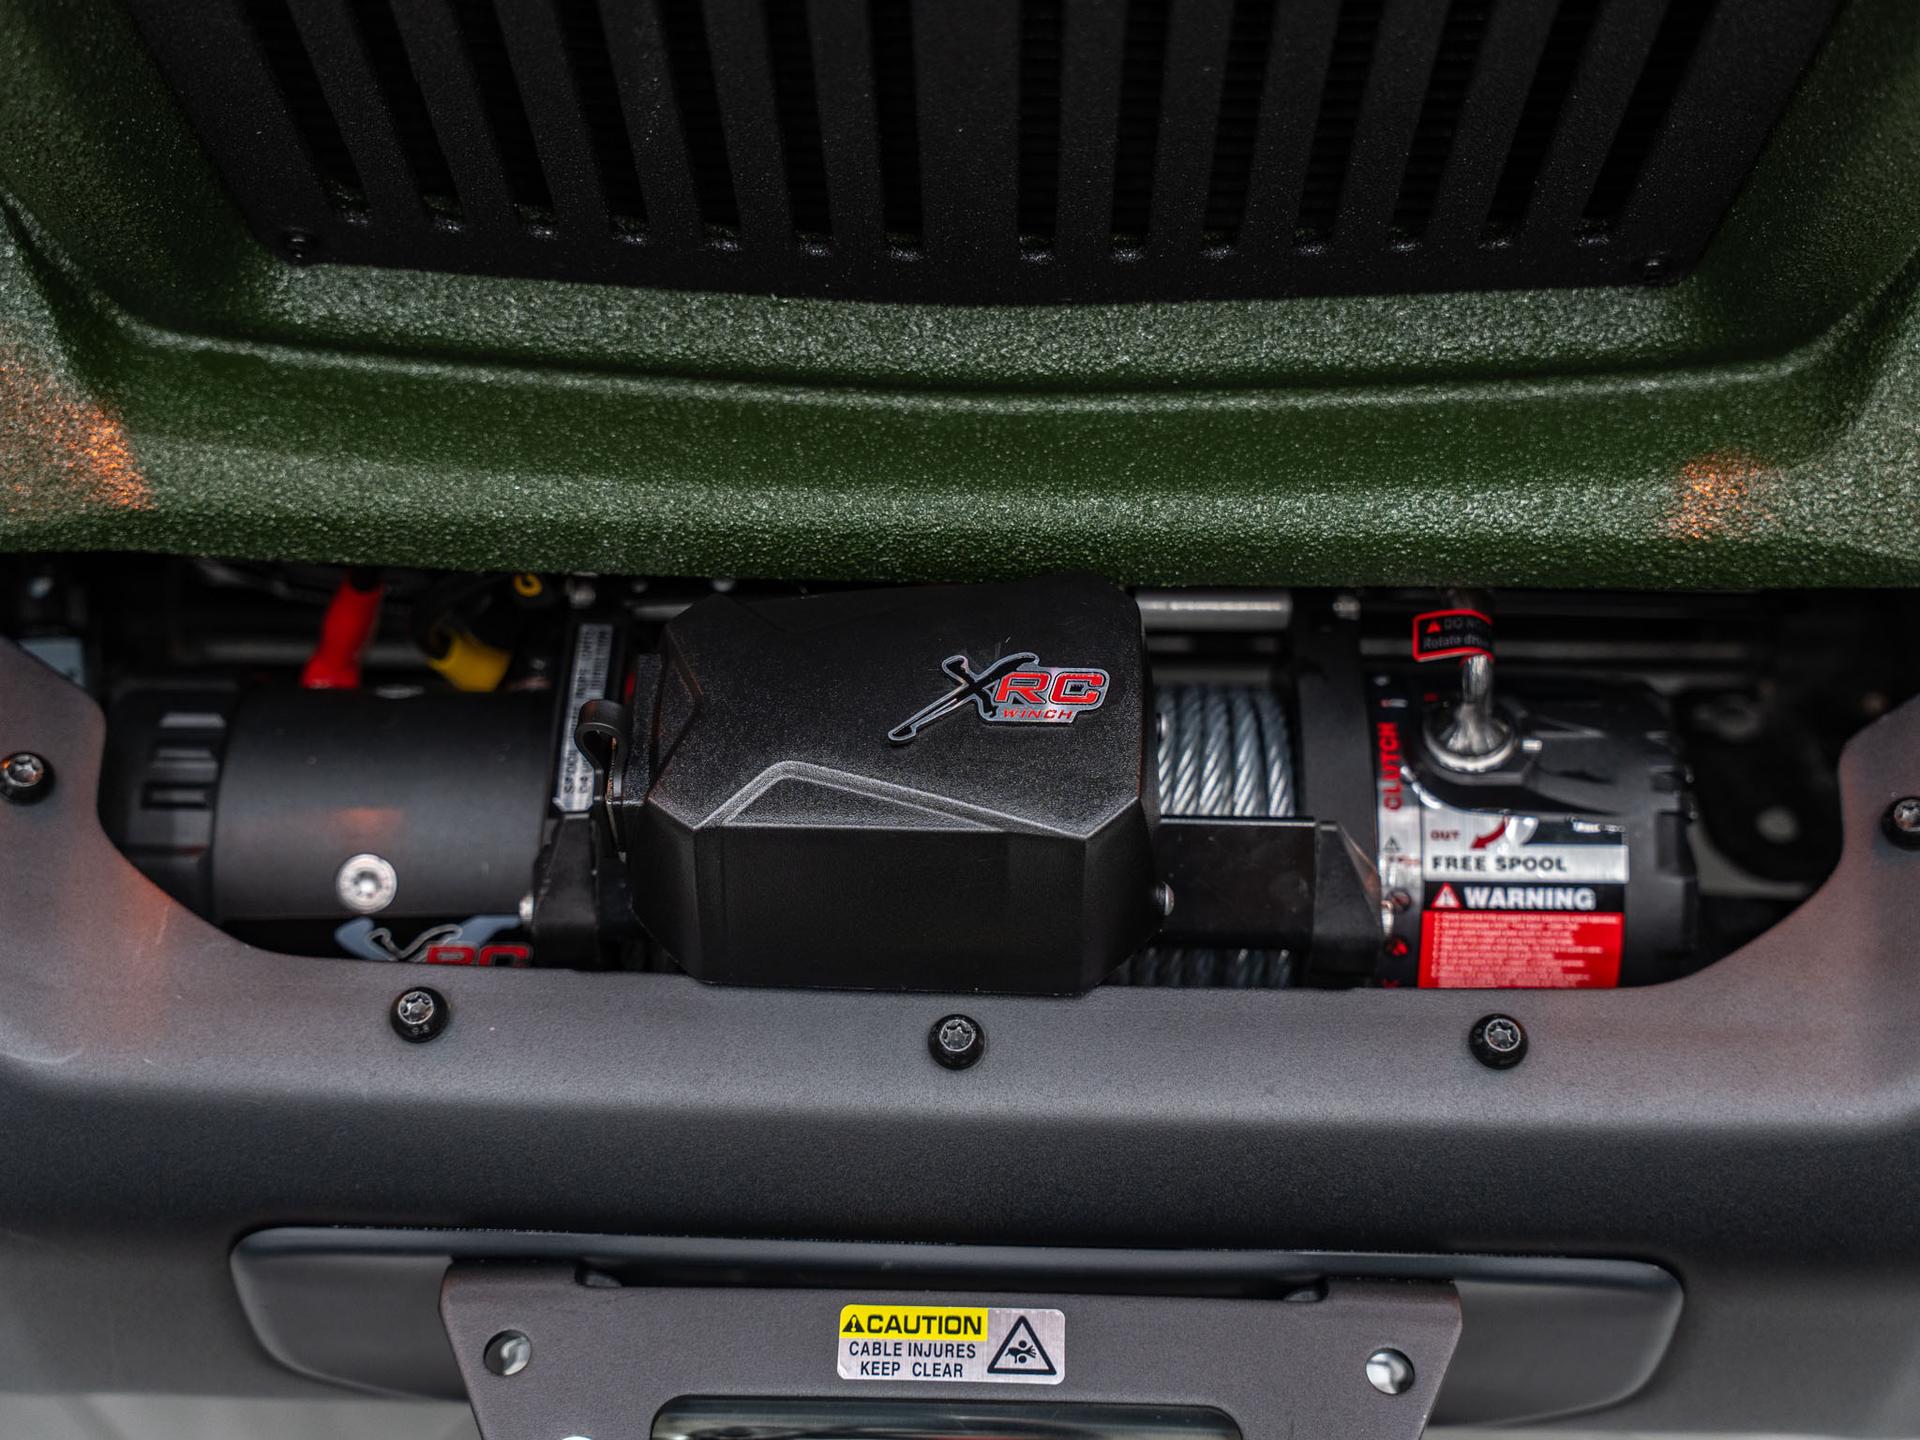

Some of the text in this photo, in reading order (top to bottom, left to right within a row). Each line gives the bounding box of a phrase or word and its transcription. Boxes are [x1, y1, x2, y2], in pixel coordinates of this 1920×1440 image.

[1003, 708, 1073, 720] WINCH
[1377, 722, 1403, 811] CLUTCH
[1430, 829, 1460, 841] OUT
[1431, 855, 1486, 873] FREE
[1495, 856, 1568, 873] SPOOL
[1464, 886, 1597, 910] WARNING
[866, 1314, 982, 1335] CAUTION
[849, 1341, 976, 1358] CABLE INJURES
[860, 1361, 963, 1378] KEEP CLEAR
